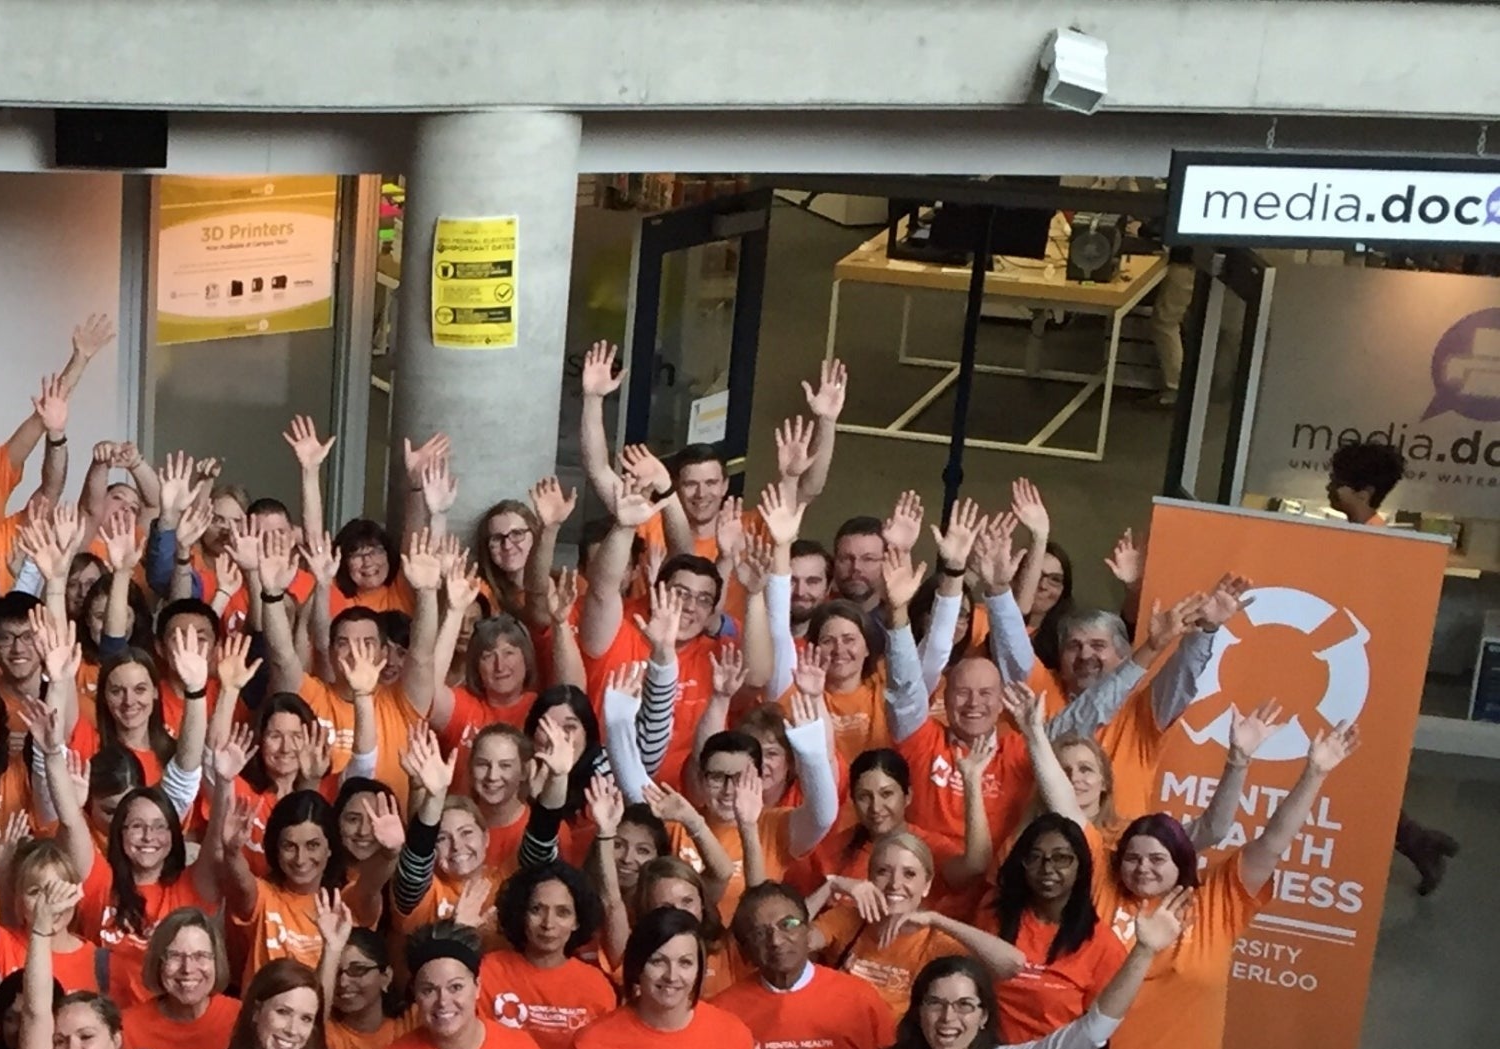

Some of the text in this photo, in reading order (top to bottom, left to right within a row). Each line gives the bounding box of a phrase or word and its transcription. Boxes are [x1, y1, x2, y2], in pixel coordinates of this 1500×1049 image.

[1203, 183, 1483, 225] media.doc
[201, 222, 294, 243] 3D Printers
